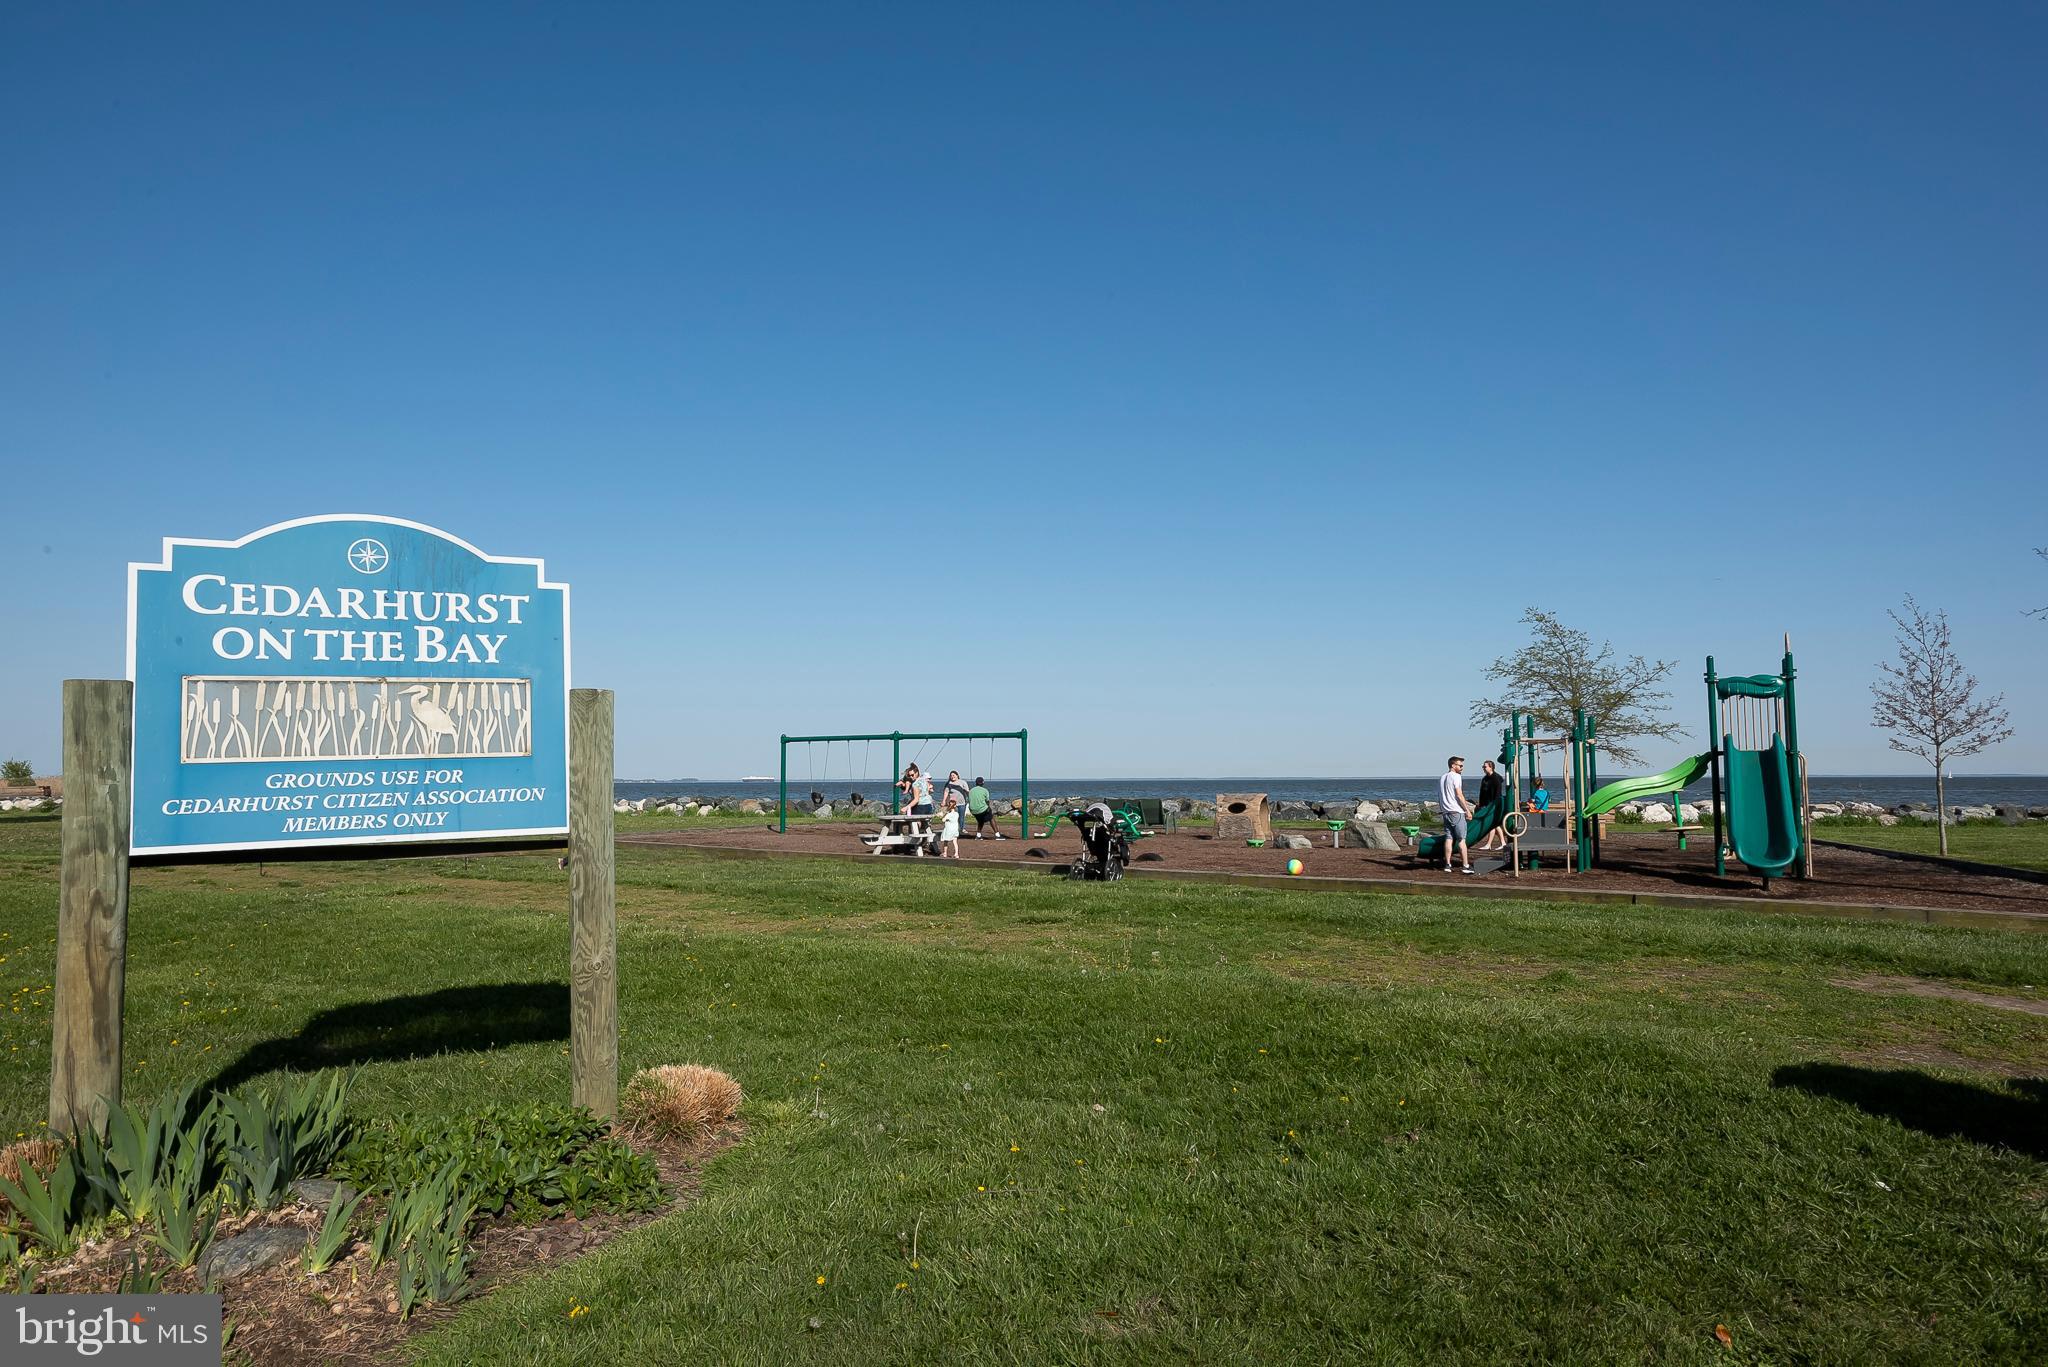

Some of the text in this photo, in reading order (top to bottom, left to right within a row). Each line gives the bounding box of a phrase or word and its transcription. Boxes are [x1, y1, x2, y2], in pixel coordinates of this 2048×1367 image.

[182, 573, 530, 625] CEDARHURST
[212, 625, 508, 664] ON THE BAY
[265, 769, 464, 789] GROUNDS USE FOR
[161, 787, 546, 815] CEDARHURST CITIZEN ASSOCIATION
[281, 811, 450, 833] MEMBERS ONLY
